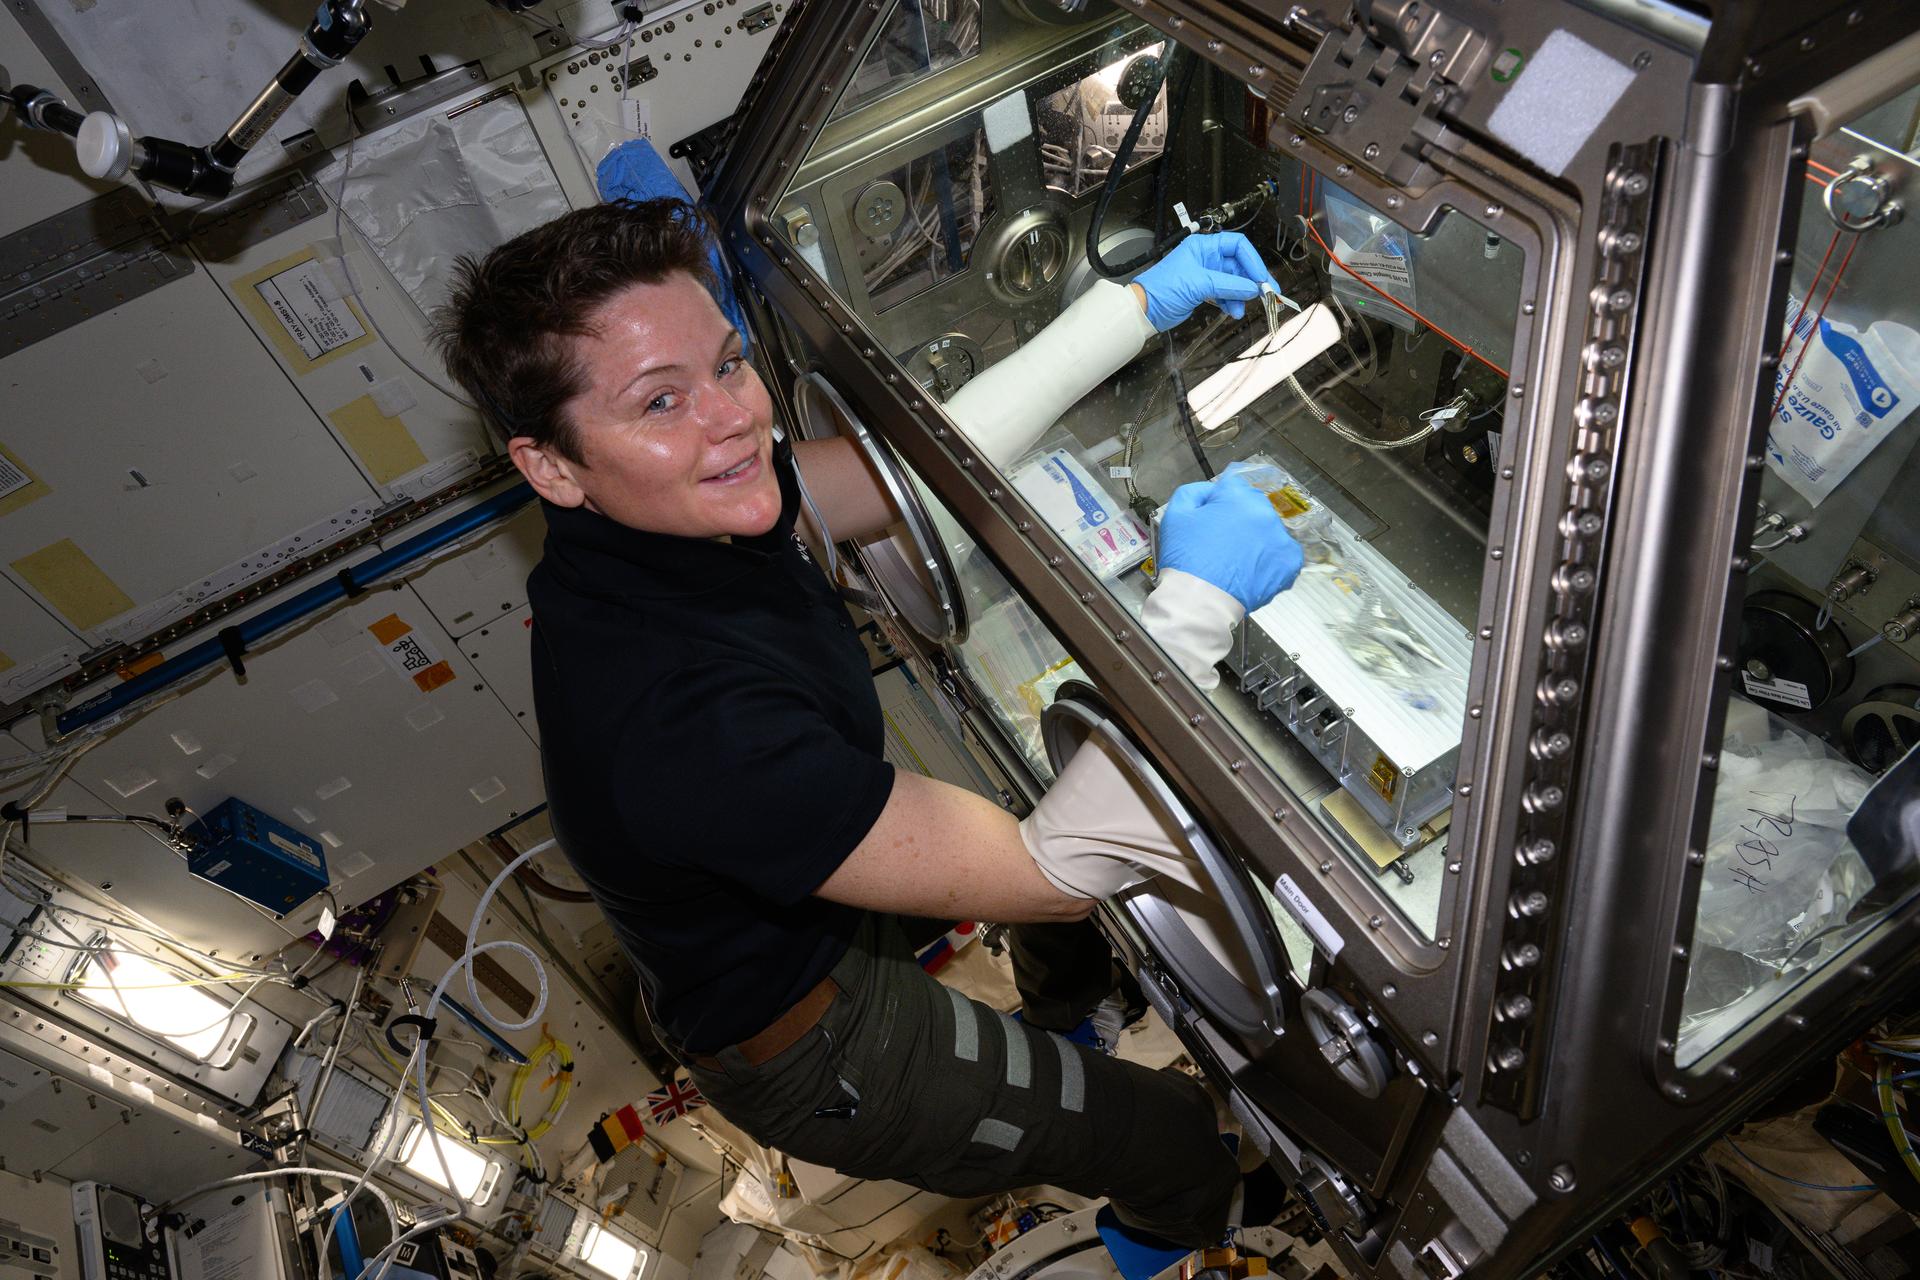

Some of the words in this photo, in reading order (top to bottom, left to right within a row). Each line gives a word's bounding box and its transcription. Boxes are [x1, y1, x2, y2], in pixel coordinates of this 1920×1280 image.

[1788, 396, 1834, 440] Gauze
[1810, 401, 1834, 420] Gauze
[1834, 421, 1842, 431] All
[1727, 790, 1797, 895] TRASH
[1279, 878, 1293, 896] Main
[1293, 895, 1309, 914] Door
